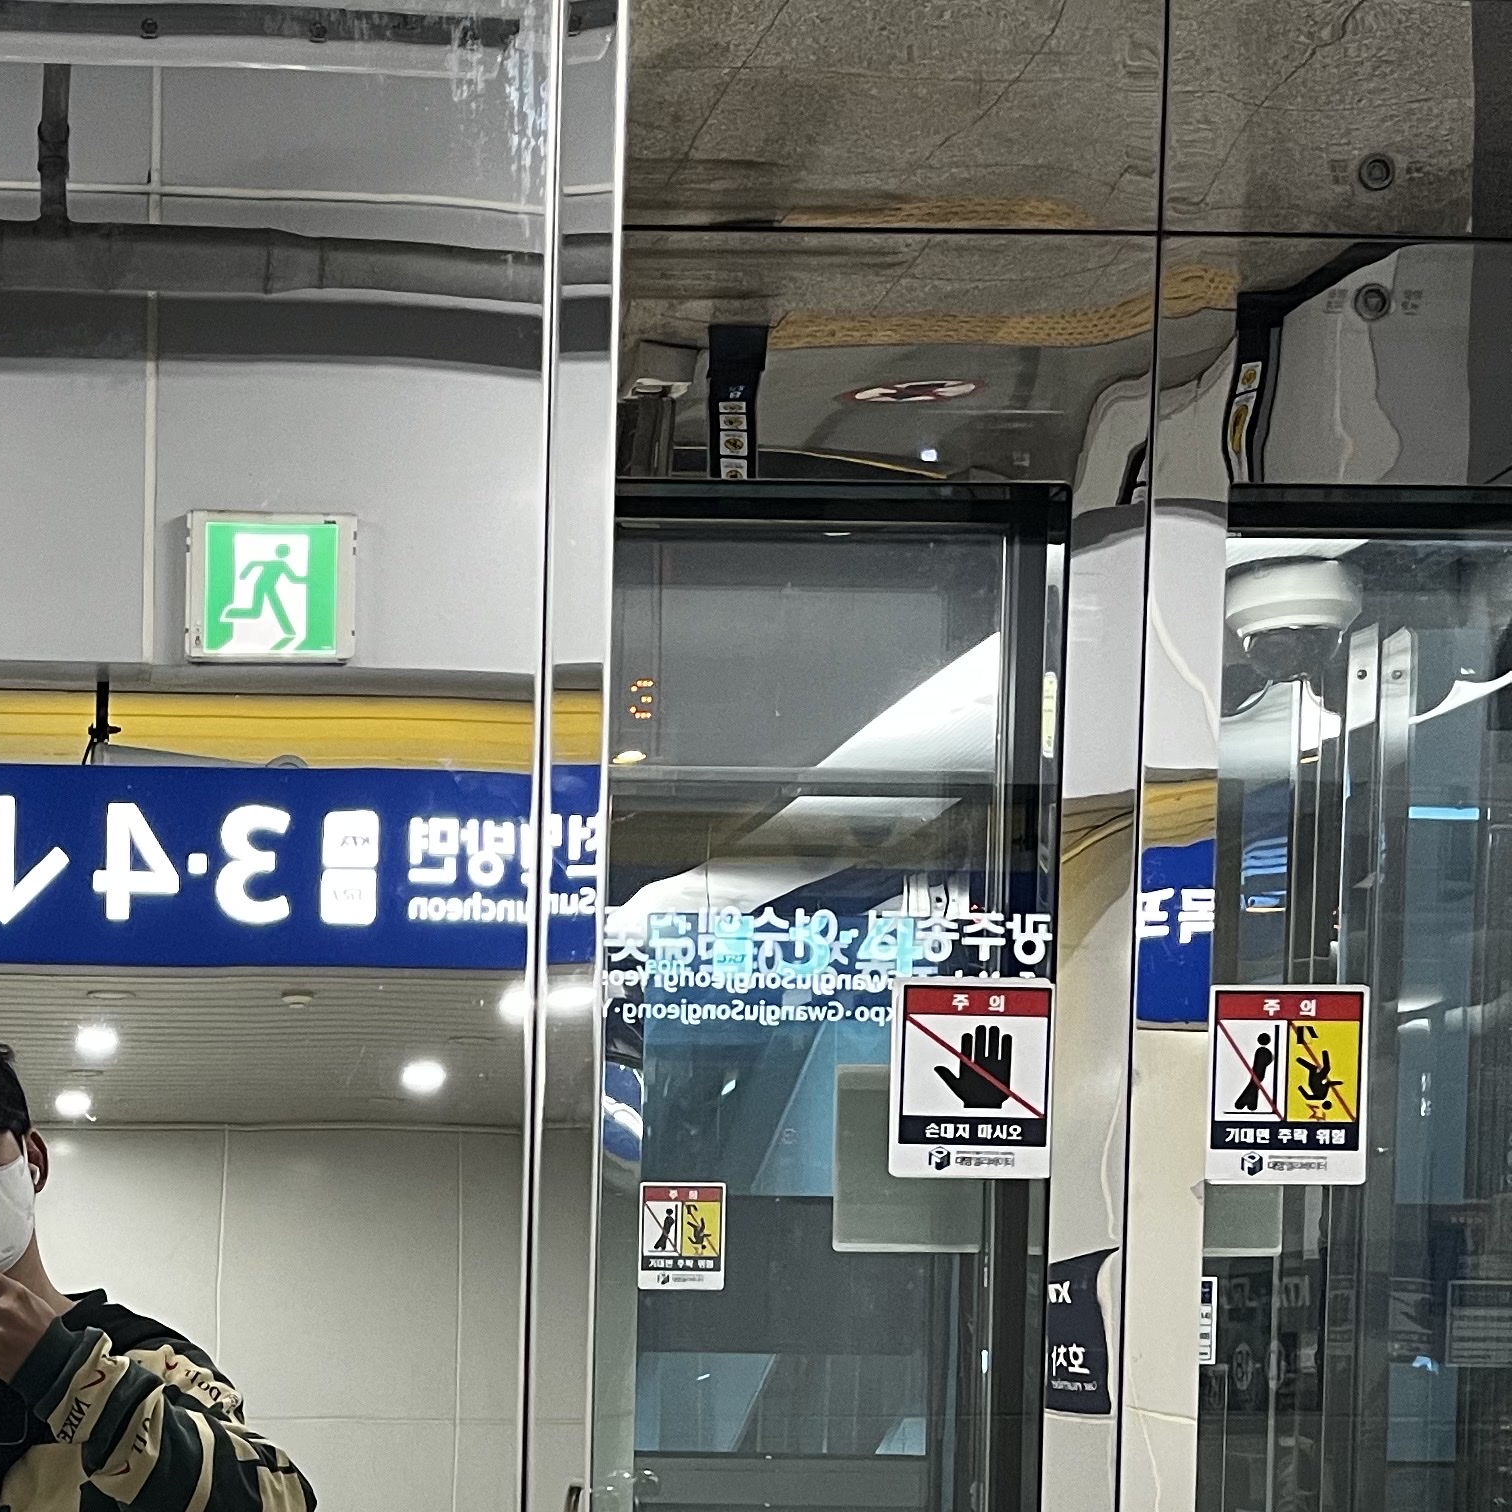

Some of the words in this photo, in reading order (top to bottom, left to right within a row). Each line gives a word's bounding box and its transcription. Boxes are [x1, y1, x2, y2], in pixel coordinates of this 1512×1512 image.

[925, 1122, 969, 1139] 손대지
[978, 1124, 1022, 1140] 마시오
[1225, 1127, 1270, 1144] 기대면
[1277, 1129, 1308, 1144] 추락
[1316, 1129, 1346, 1145] 위험
